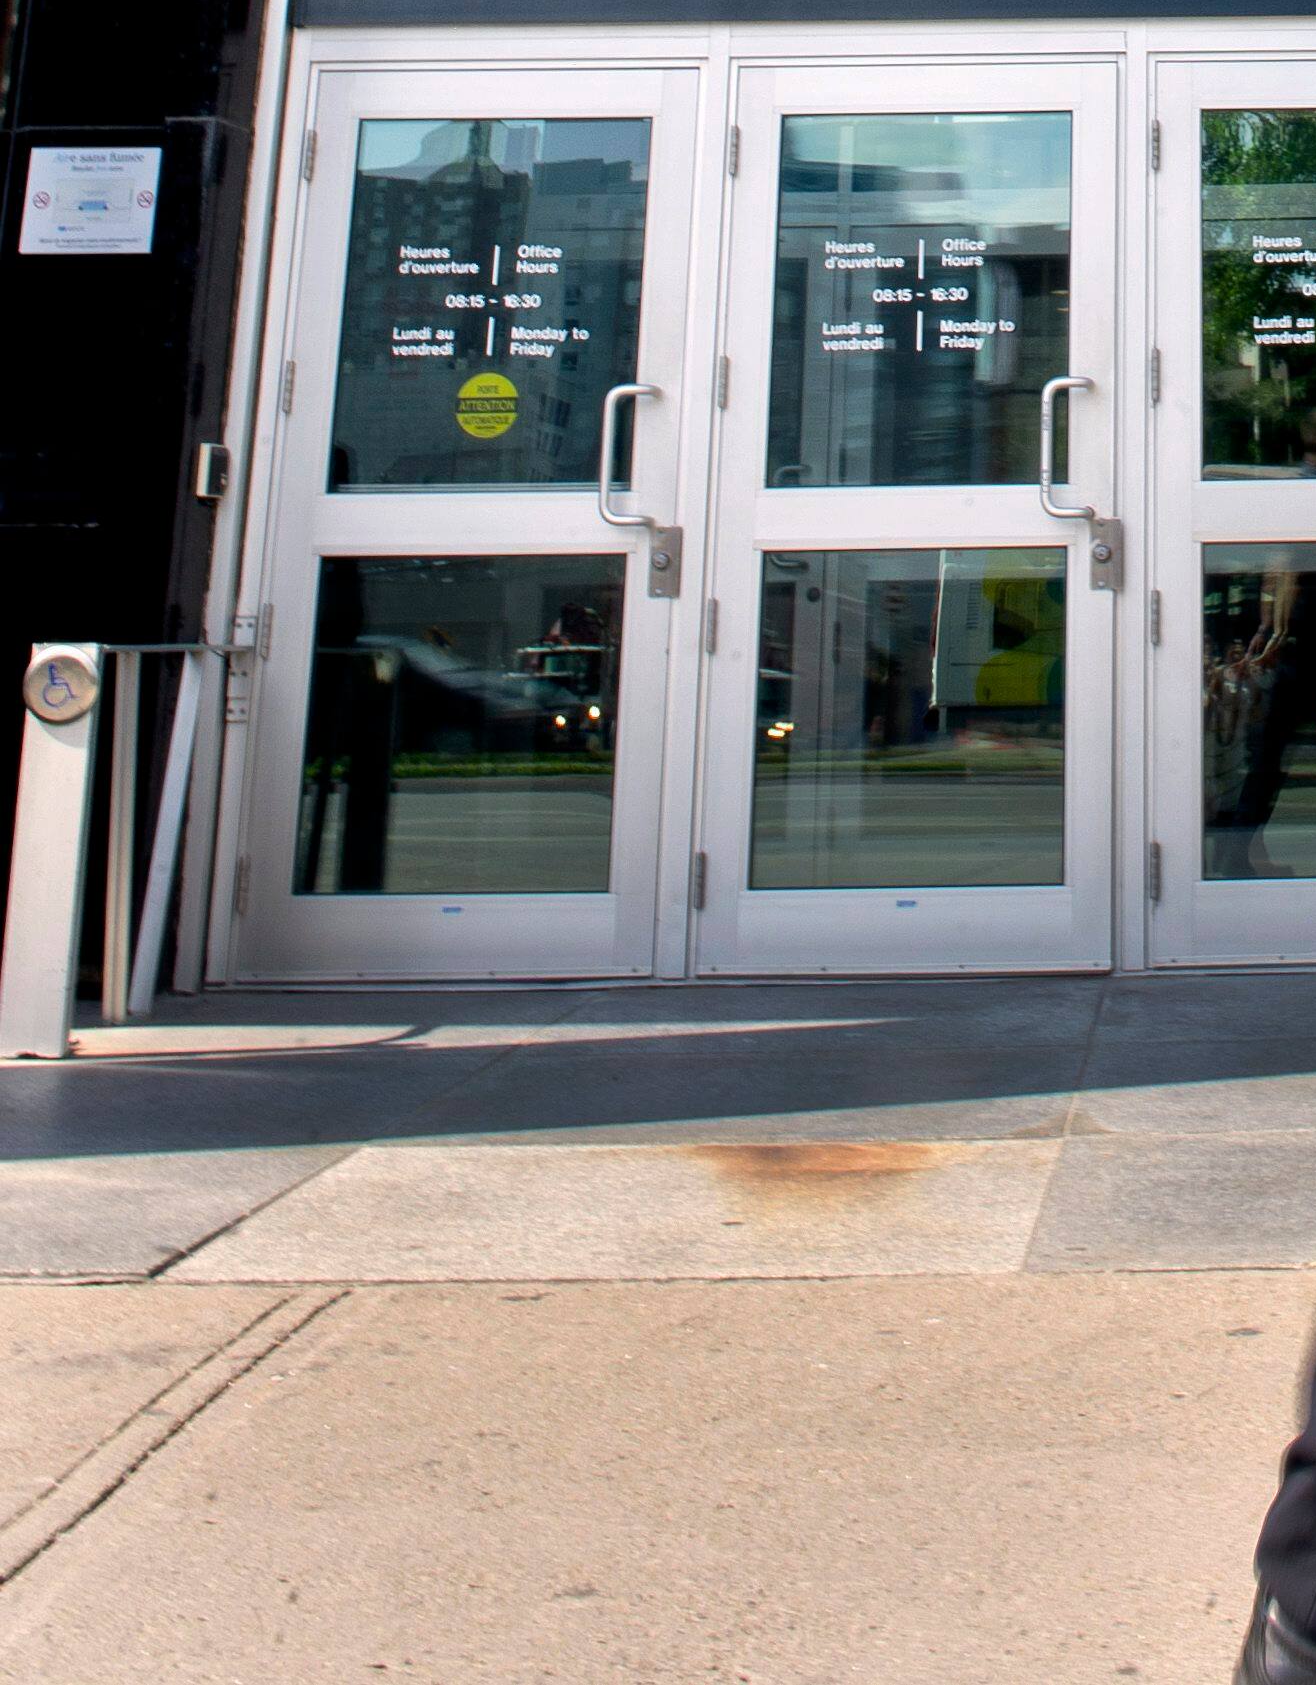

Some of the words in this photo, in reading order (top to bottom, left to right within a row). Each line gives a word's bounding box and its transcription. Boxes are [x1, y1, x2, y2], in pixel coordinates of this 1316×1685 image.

[825, 241, 875, 254] Heures
[942, 238, 987, 252] Office
[1252, 235, 1302, 248] Heures
[400, 246, 450, 259] Heures
[518, 245, 563, 259] Office
[516, 260, 559, 274] Hours
[942, 253, 984, 267] Hours
[445, 295, 485, 309] 08:15
[873, 289, 913, 303] 08:15
[822, 322, 861, 335] Lundi
[864, 323, 884, 335] au
[940, 319, 997, 334] Monday
[999, 318, 1016, 332] to
[1254, 316, 1292, 329] Lundi
[1296, 317, 1315, 328] au
[393, 327, 432, 340] Lundi
[436, 329, 455, 341] au
[511, 327, 568, 343] Monday
[572, 327, 590, 340] to
[1254, 331, 1316, 345] vendredi
[392, 342, 454, 356] vendredi
[822, 337, 885, 351] vendredi
[940, 335, 985, 350] Friday
[510, 342, 555, 358] Friday
